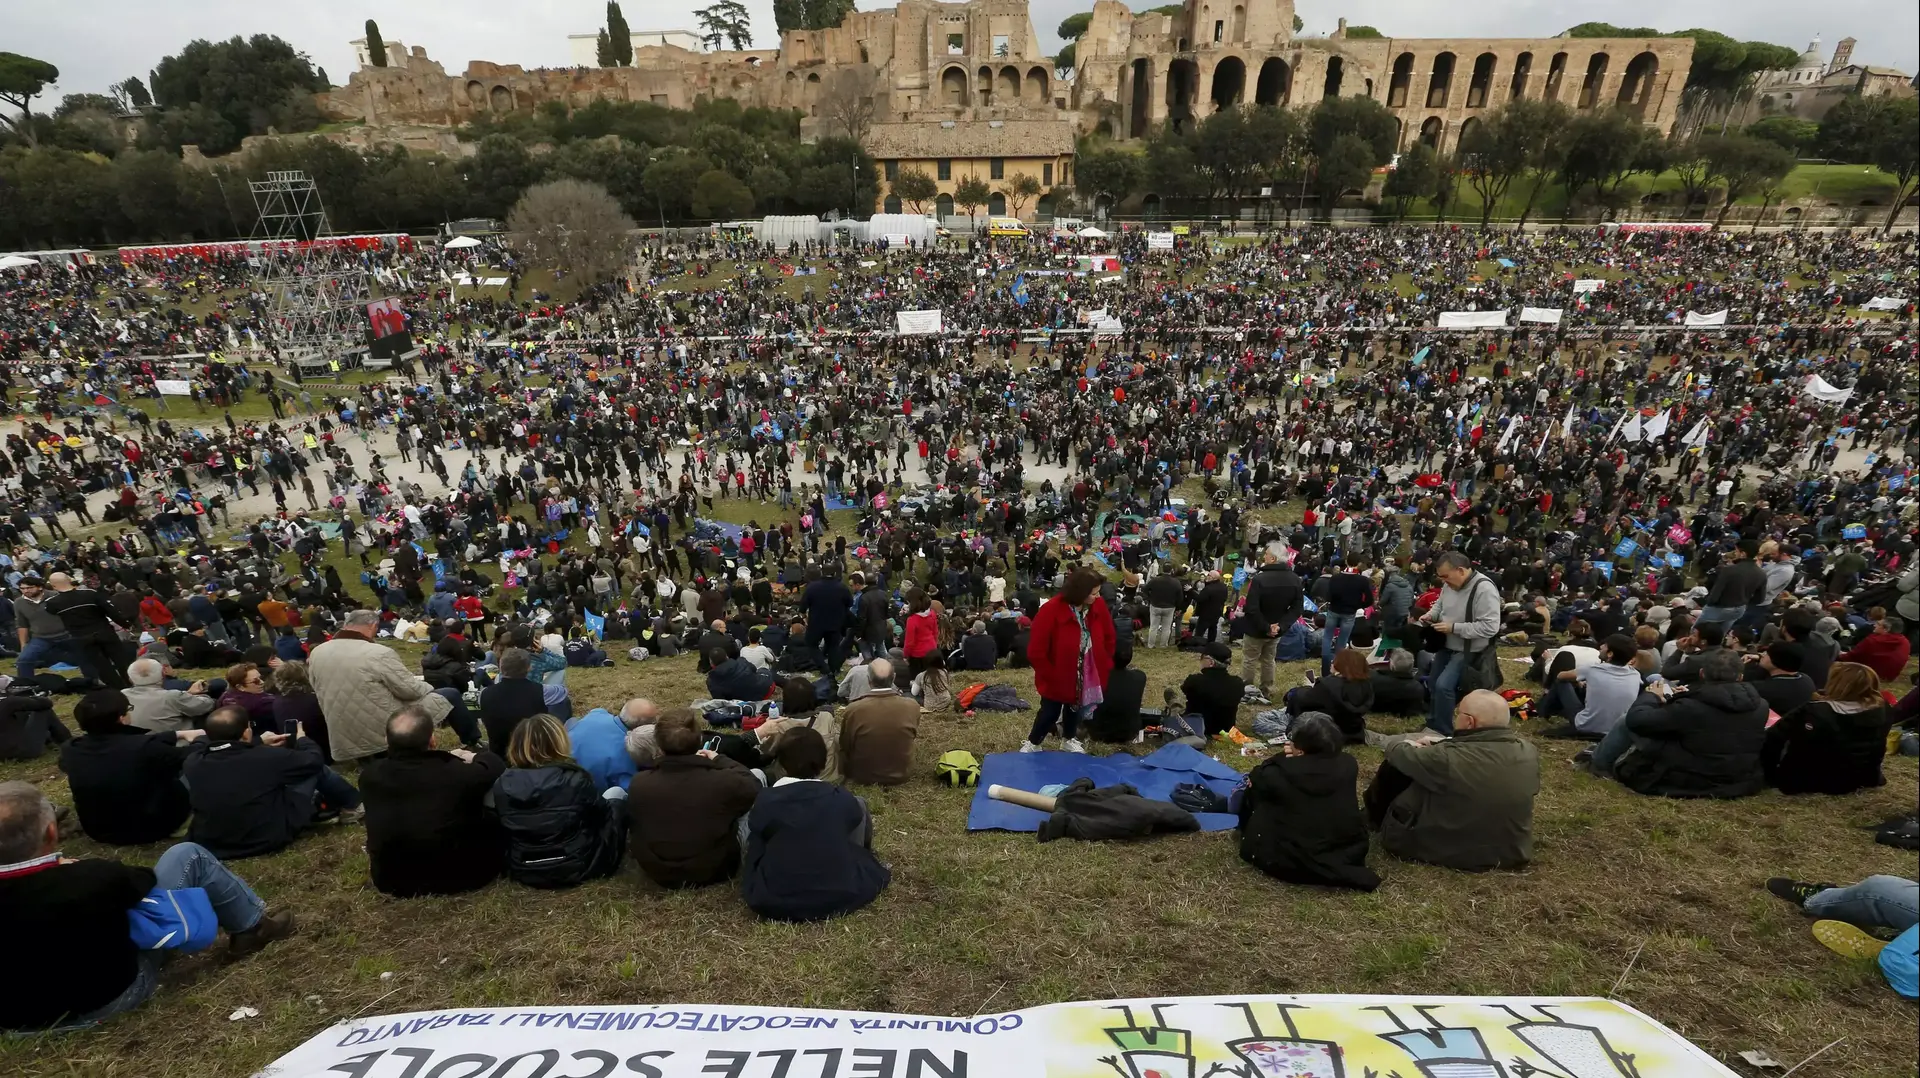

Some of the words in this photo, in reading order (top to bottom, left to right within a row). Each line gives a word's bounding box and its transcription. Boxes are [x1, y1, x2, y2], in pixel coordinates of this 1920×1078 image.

[336, 1012, 496, 1048] TARANTO
[499, 1011, 839, 1032] NEOCATECUMENALI
[849, 1013, 1024, 1036] COMUNITÀ
[700, 1047, 969, 1078] NELLE
